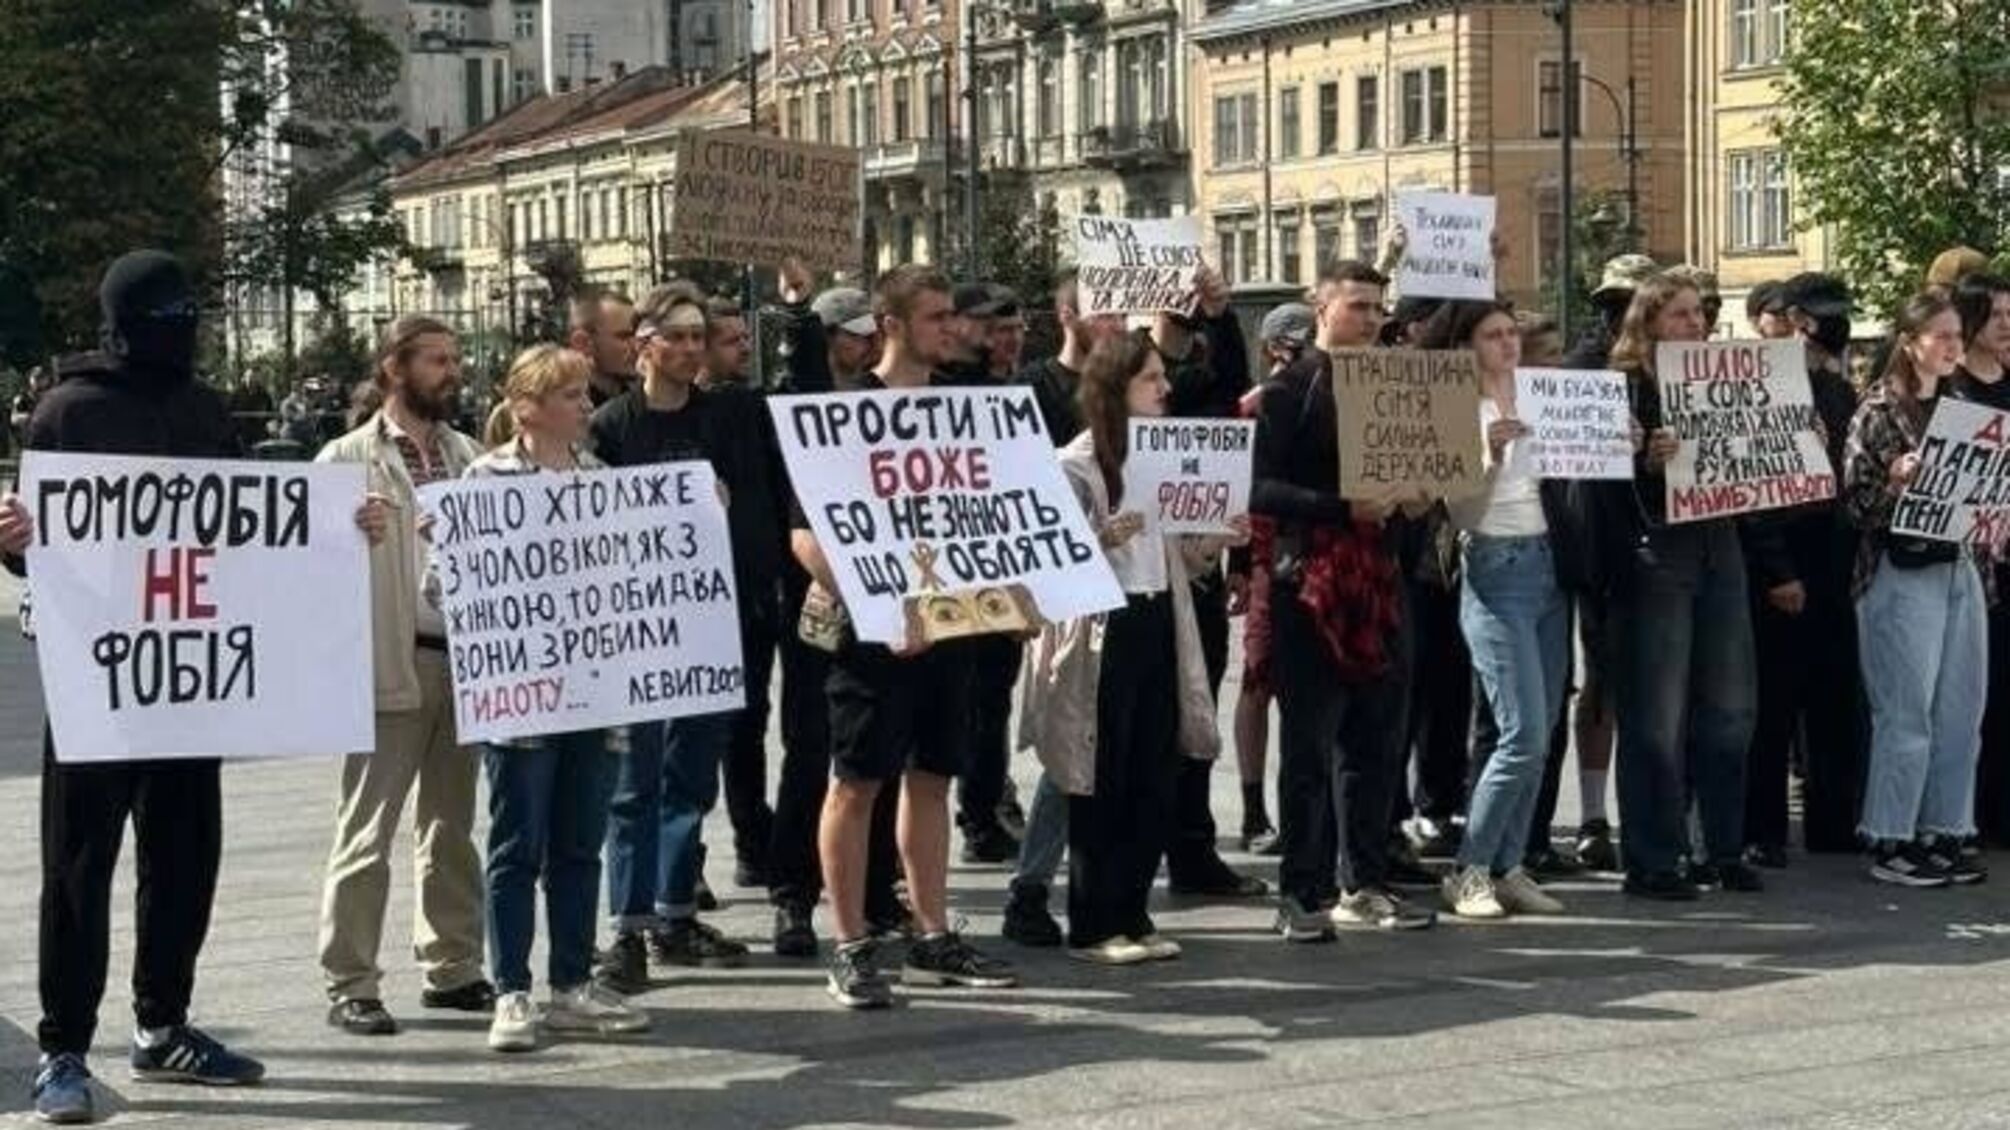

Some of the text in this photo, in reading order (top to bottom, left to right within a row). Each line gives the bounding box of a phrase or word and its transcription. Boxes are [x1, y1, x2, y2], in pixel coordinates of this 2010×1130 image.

[704, 140, 804, 181] СТВОРИВ
[1119, 241, 1146, 267] ЦЕ
[1081, 266, 1181, 290] ЧОЛОВІКА
[1091, 290, 1113, 311] ТА
[1684, 348, 1773, 382] ШЛЮБ
[1665, 377, 1772, 413] ЦЕ СОЮЗ
[792, 395, 1041, 449] ПРОСТИ ЇМ
[1135, 425, 1250, 452] ГОМОФОБІЯ
[1363, 422, 1440, 449] СИЛЬНА
[1360, 452, 1466, 483] ДЕРЖАВА
[1698, 438, 1732, 461] ВСЕ
[869, 446, 992, 499] БОЖЕ
[38, 471, 310, 548] ГОМОФОБІЯ
[545, 476, 607, 526] ХТО
[612, 471, 695, 512] ЛЯЖЕ
[825, 487, 1061, 545] БО НЕ ЗНАЮТЬ
[1158, 481, 1230, 521] ФОБІЯ
[1895, 498, 1955, 535] МЕНІ
[445, 554, 461, 596] З
[681, 522, 699, 560] З
[853, 552, 908, 601] ЩО
[143, 546, 218, 622] НЕ
[610, 567, 731, 615] ОБИДВА
[92, 624, 256, 711] ФОБІЯ
[453, 616, 681, 684] ВОНИ ЗРОБИЛИ
